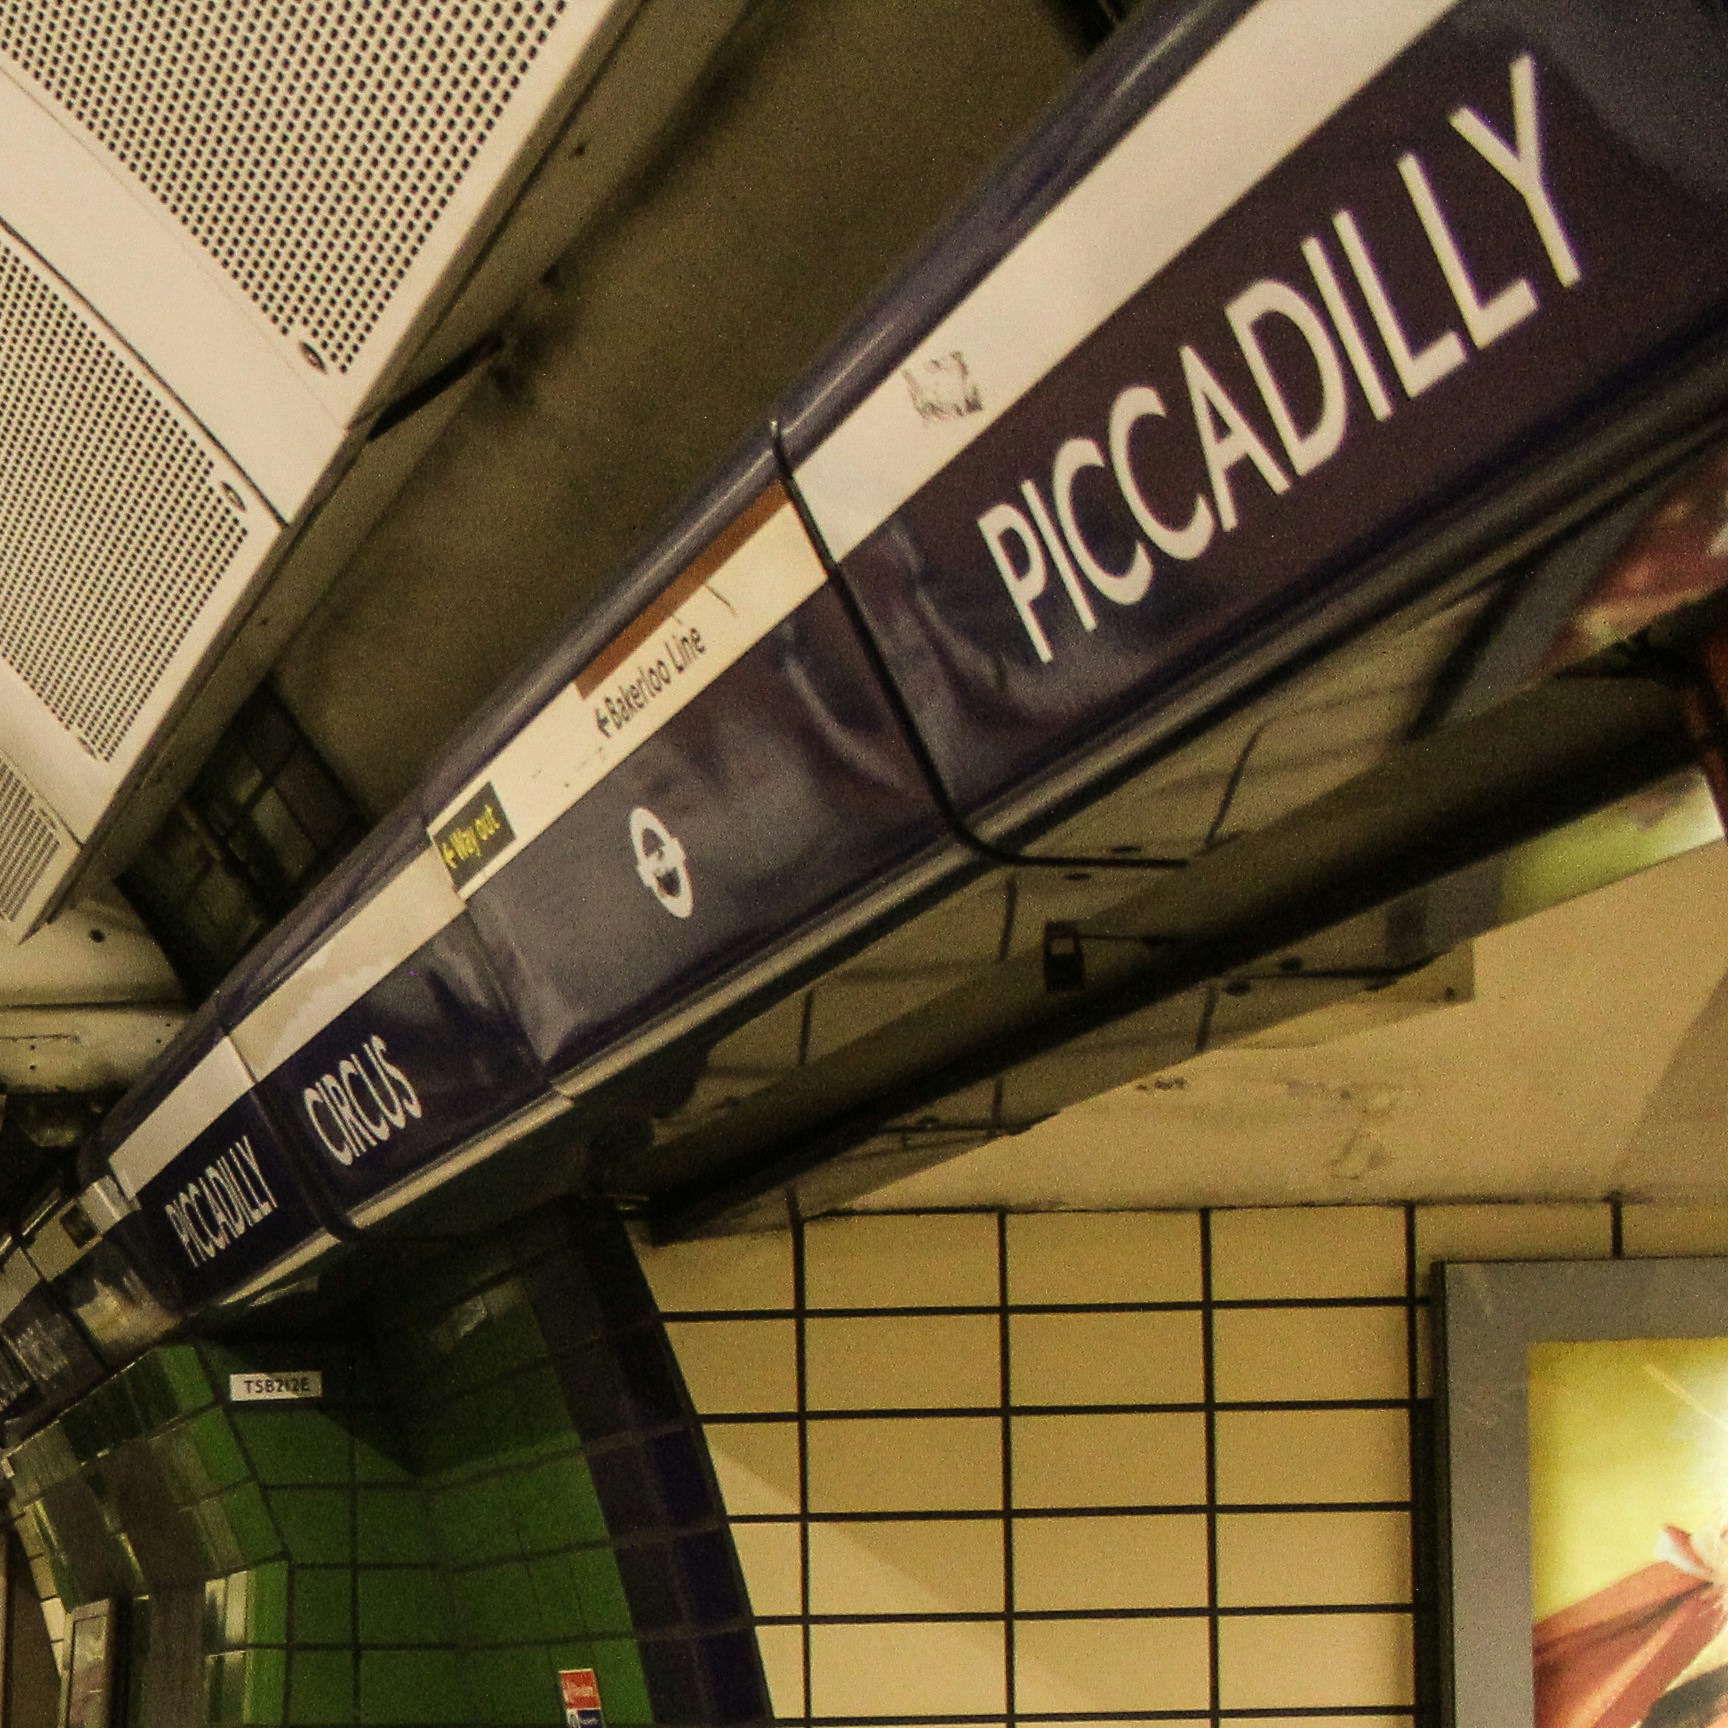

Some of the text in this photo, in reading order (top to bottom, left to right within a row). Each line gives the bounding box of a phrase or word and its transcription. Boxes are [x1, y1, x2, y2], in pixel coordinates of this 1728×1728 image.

[977, 54, 1582, 663] PICCADILLY
[605, 624, 707, 729] Bakerloo Line
[453, 804, 503, 862] Way out
[164, 1034, 424, 1269] PICCADILLY CIRCUS
